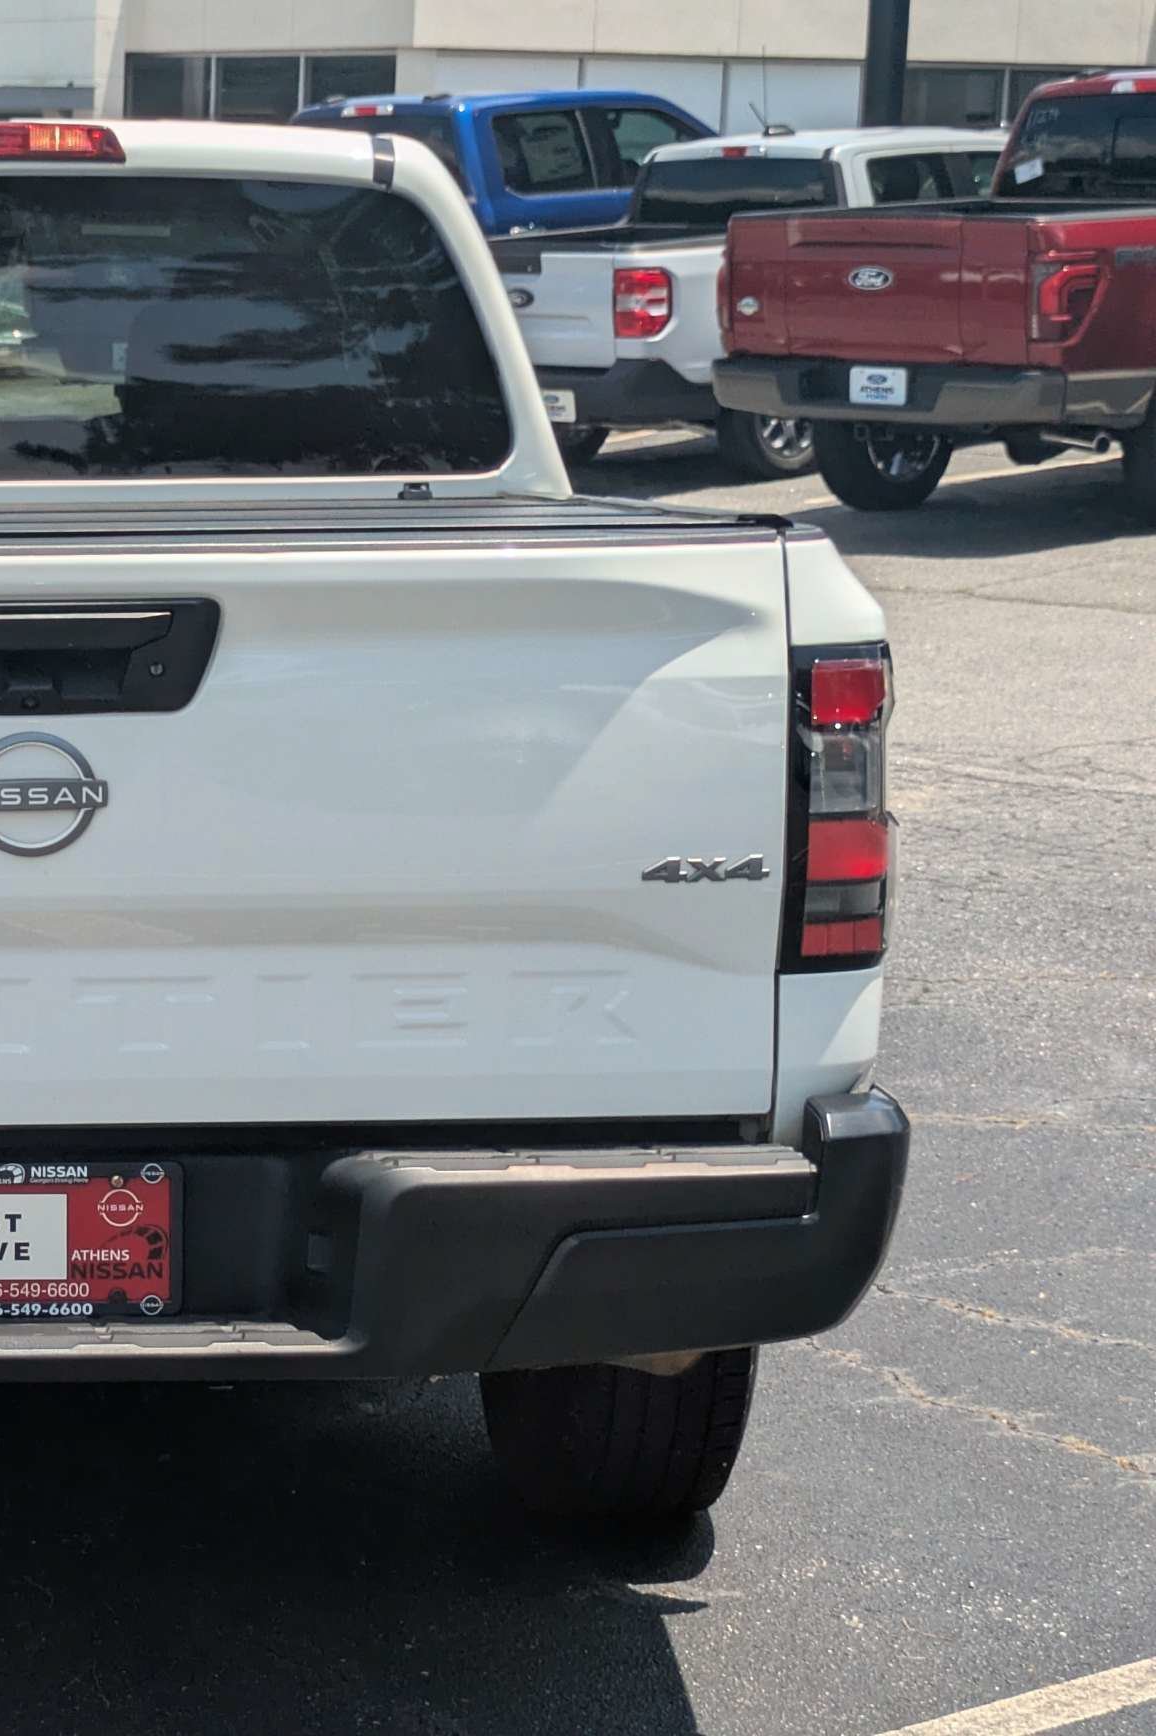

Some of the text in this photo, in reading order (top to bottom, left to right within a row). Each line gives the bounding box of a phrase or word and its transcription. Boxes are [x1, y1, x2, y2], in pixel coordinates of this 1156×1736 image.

[31, 1166, 88, 1178] NISSAN
[97, 1204, 144, 1212] NISSAN
[71, 1249, 130, 1261] ATHENS
[70, 1262, 163, 1280] NISSAN
